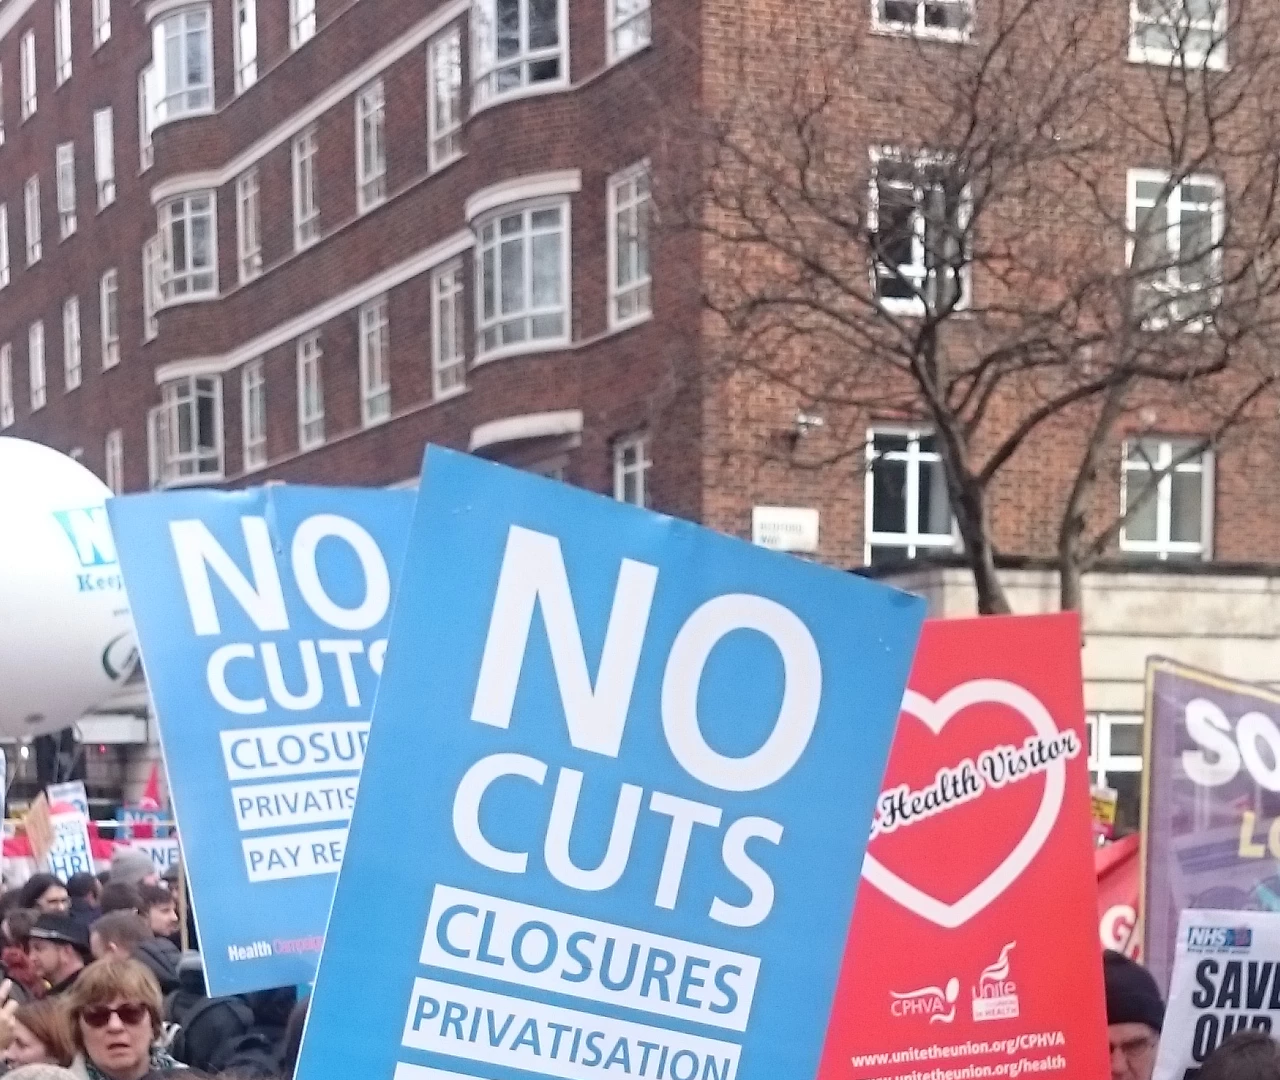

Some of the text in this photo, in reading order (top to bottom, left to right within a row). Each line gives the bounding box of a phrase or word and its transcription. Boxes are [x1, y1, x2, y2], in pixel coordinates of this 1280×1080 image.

[169, 514, 391, 637] NO
[469, 524, 823, 793] NO
[882, 734, 1077, 828] Health Visitor
[249, 846, 301, 874] PAY
[452, 752, 786, 928] CUTS
[227, 938, 272, 963] Health
[435, 903, 743, 1015] CLOSURES
[1189, 927, 1228, 947] NHS
[890, 996, 944, 1017] CPHVA
[851, 1030, 1066, 1068] www.unitetheunion.org/CPHVA
